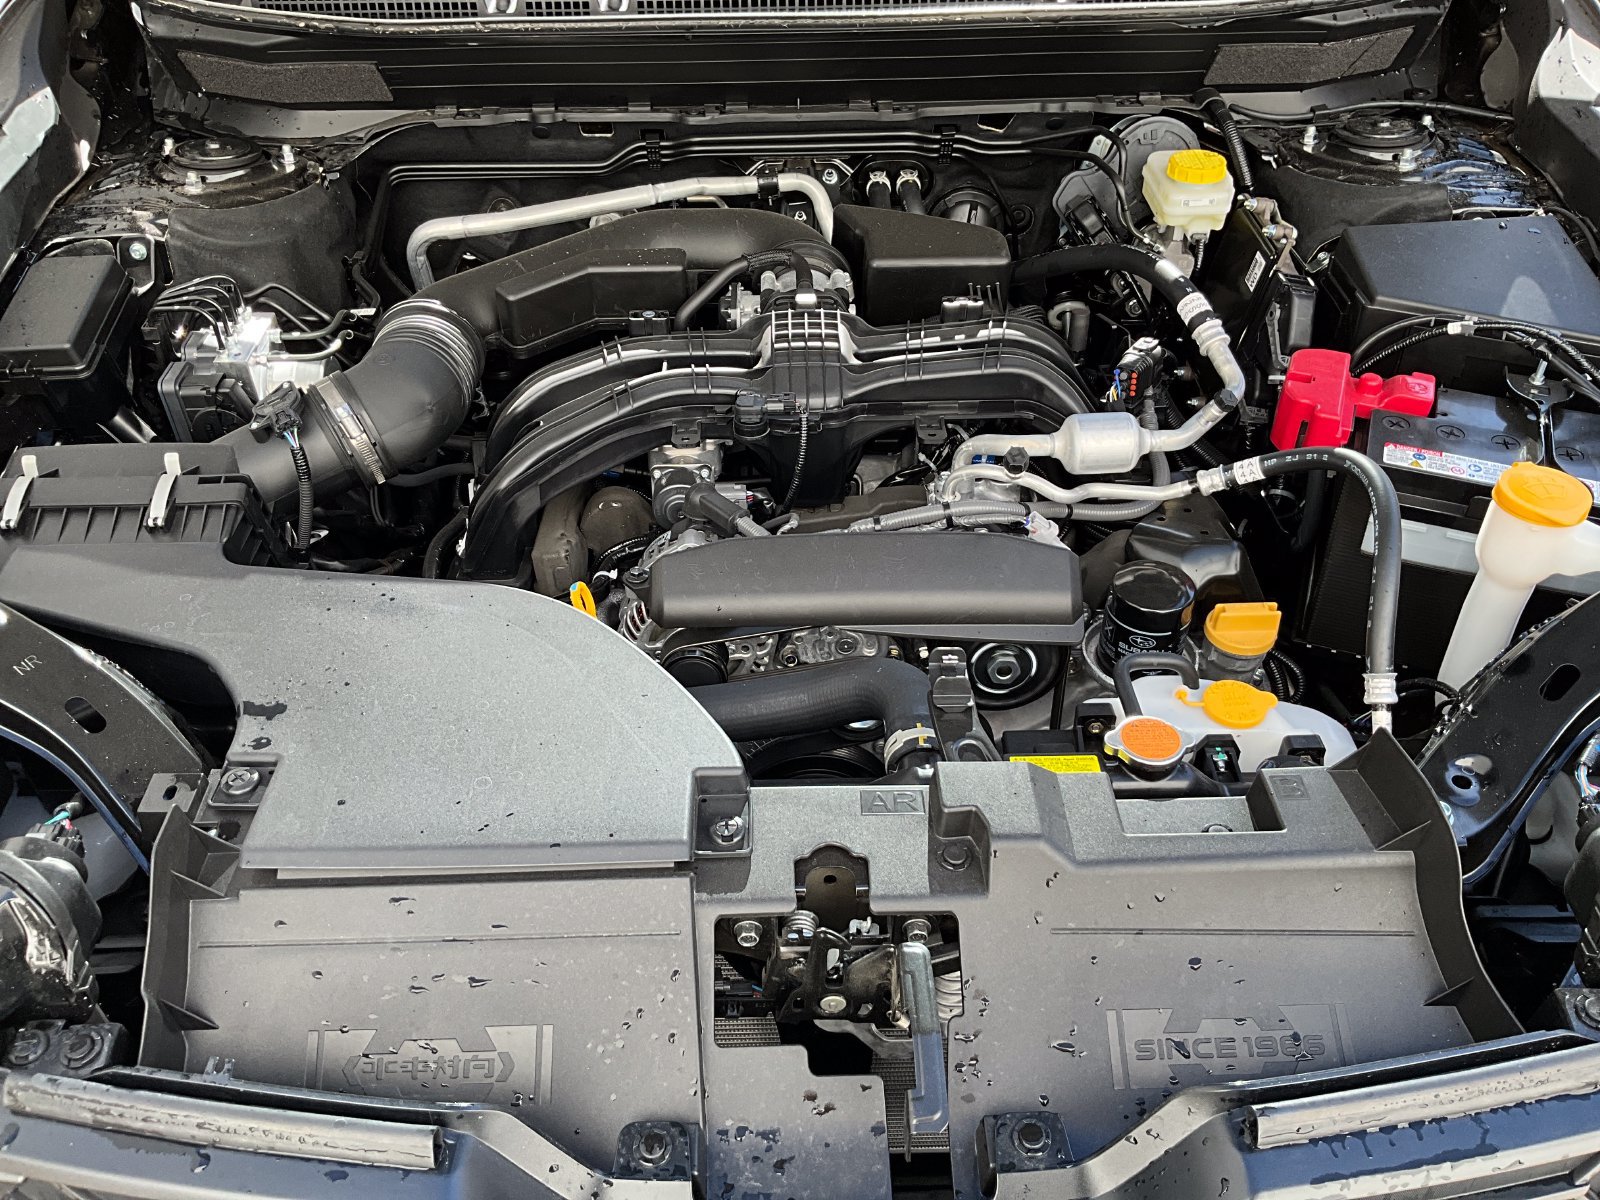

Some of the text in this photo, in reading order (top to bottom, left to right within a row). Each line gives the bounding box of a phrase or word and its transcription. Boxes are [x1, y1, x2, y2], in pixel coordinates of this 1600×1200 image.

[1396, 444, 1418, 453] DANGER
[12, 654, 43, 676] NR
[870, 791, 921, 813] AR
[1135, 1036, 1238, 1061] SINCE
